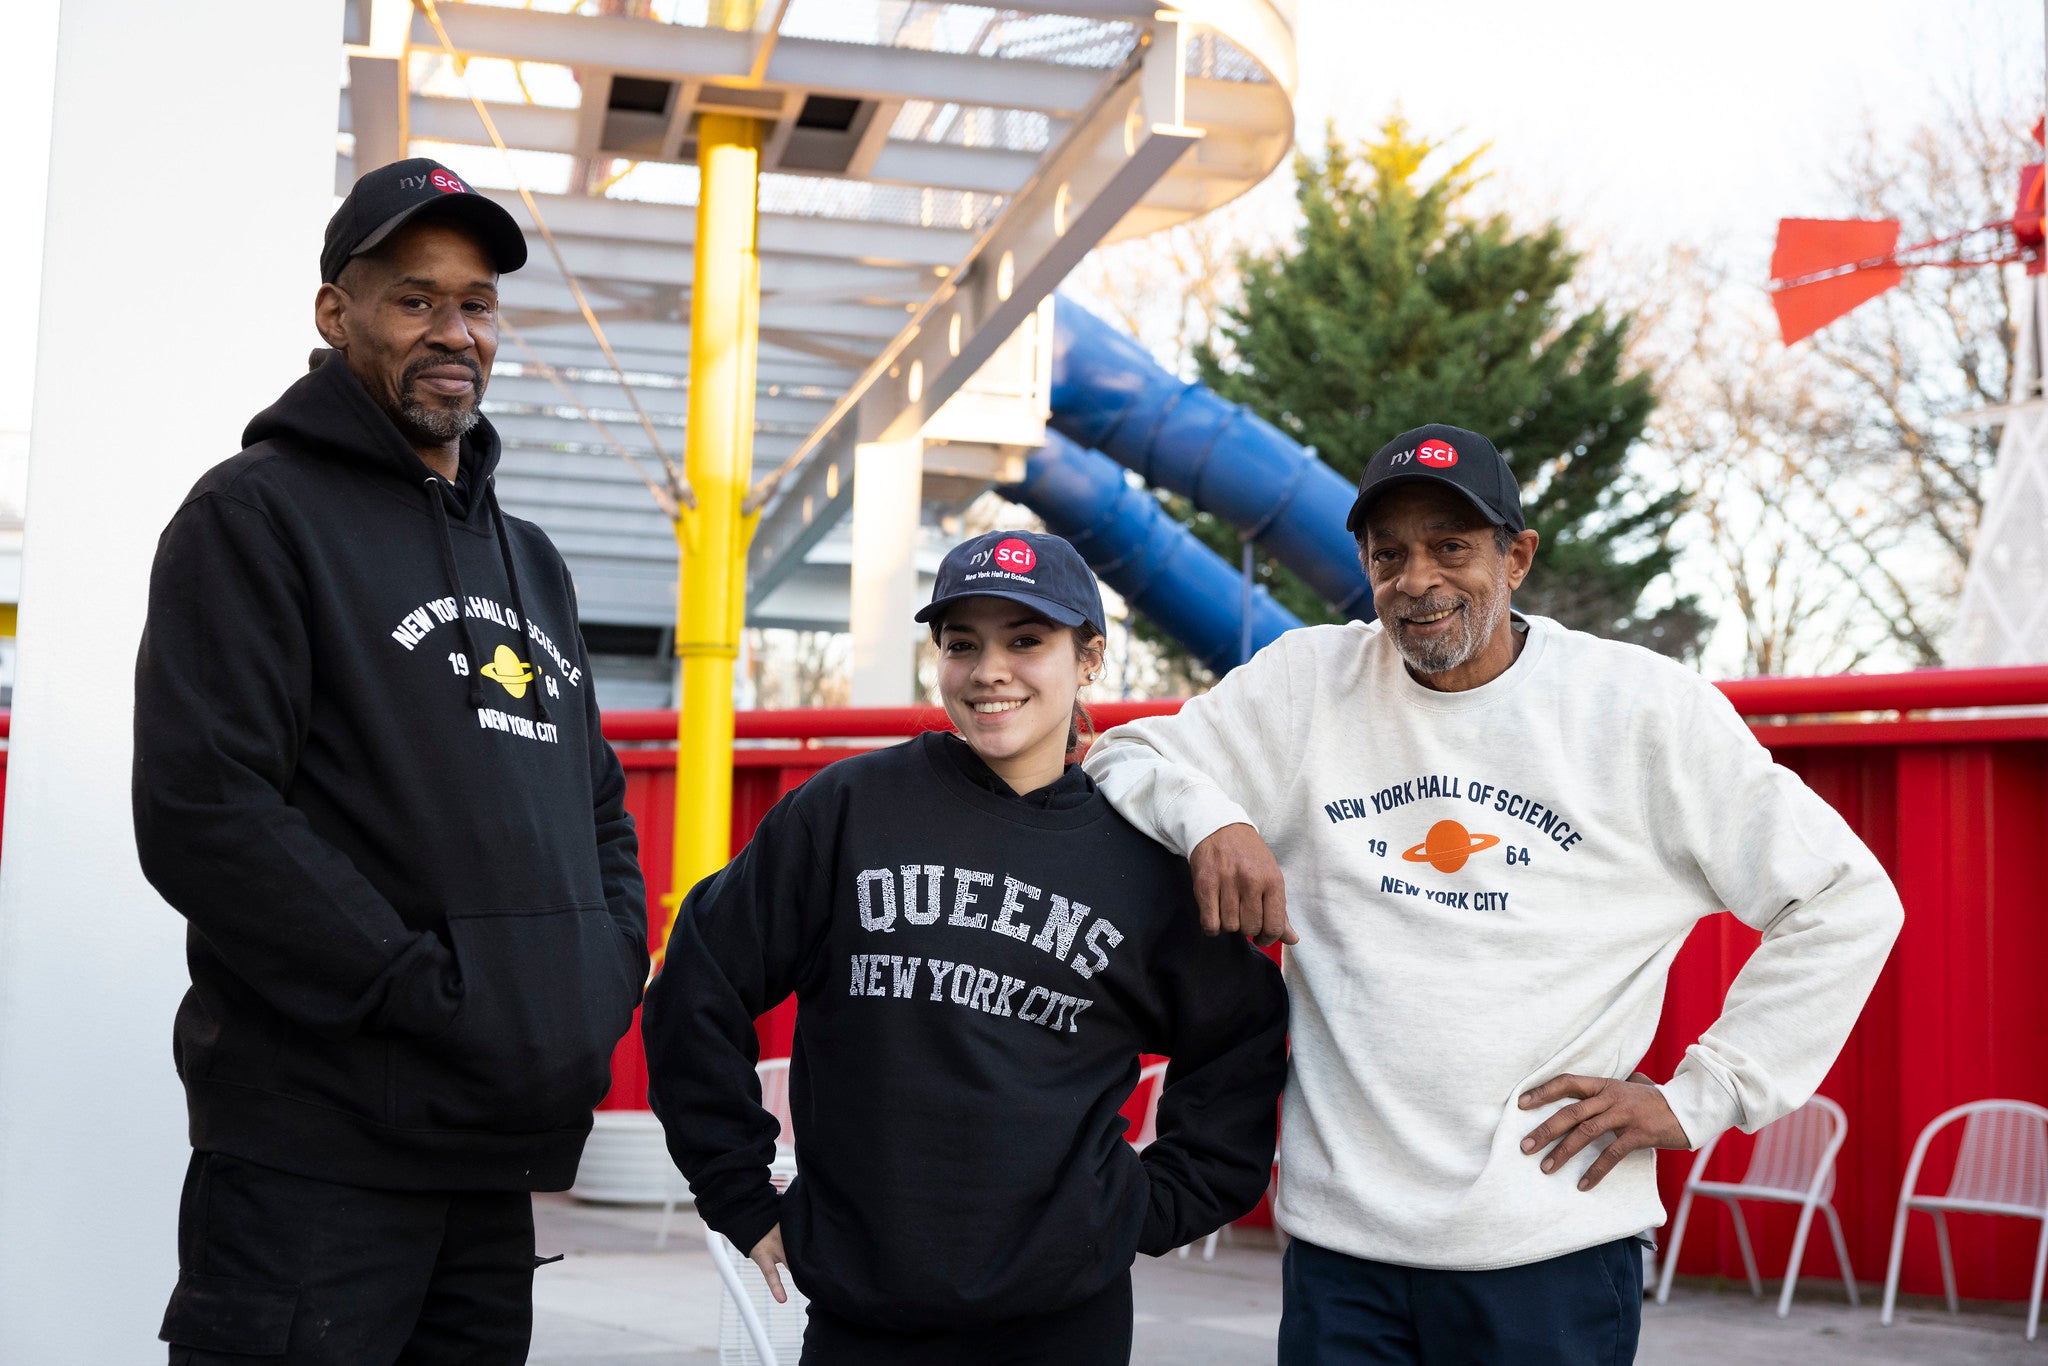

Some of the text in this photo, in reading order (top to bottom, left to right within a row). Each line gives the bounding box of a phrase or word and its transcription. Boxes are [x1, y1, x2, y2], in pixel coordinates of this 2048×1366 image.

[965, 573, 978, 581] New
[977, 571, 991, 579] York
[1010, 573, 1036, 585] Science
[391, 606, 436, 651] NEW
[468, 596, 506, 627] HALL
[505, 607, 521, 631] O
[526, 618, 582, 687] SCIENCE
[448, 652, 560, 700] 19 64
[477, 708, 558, 744] NEW YORK CITY
[1324, 775, 1583, 852] NEW YORK HALL OF SCIENCE
[1367, 838, 1531, 867] 19 64
[1380, 875, 1509, 911] NEW YORK CITY
[856, 864, 1125, 980] QUEENS
[849, 954, 1094, 1033] NEW YORK CITY
